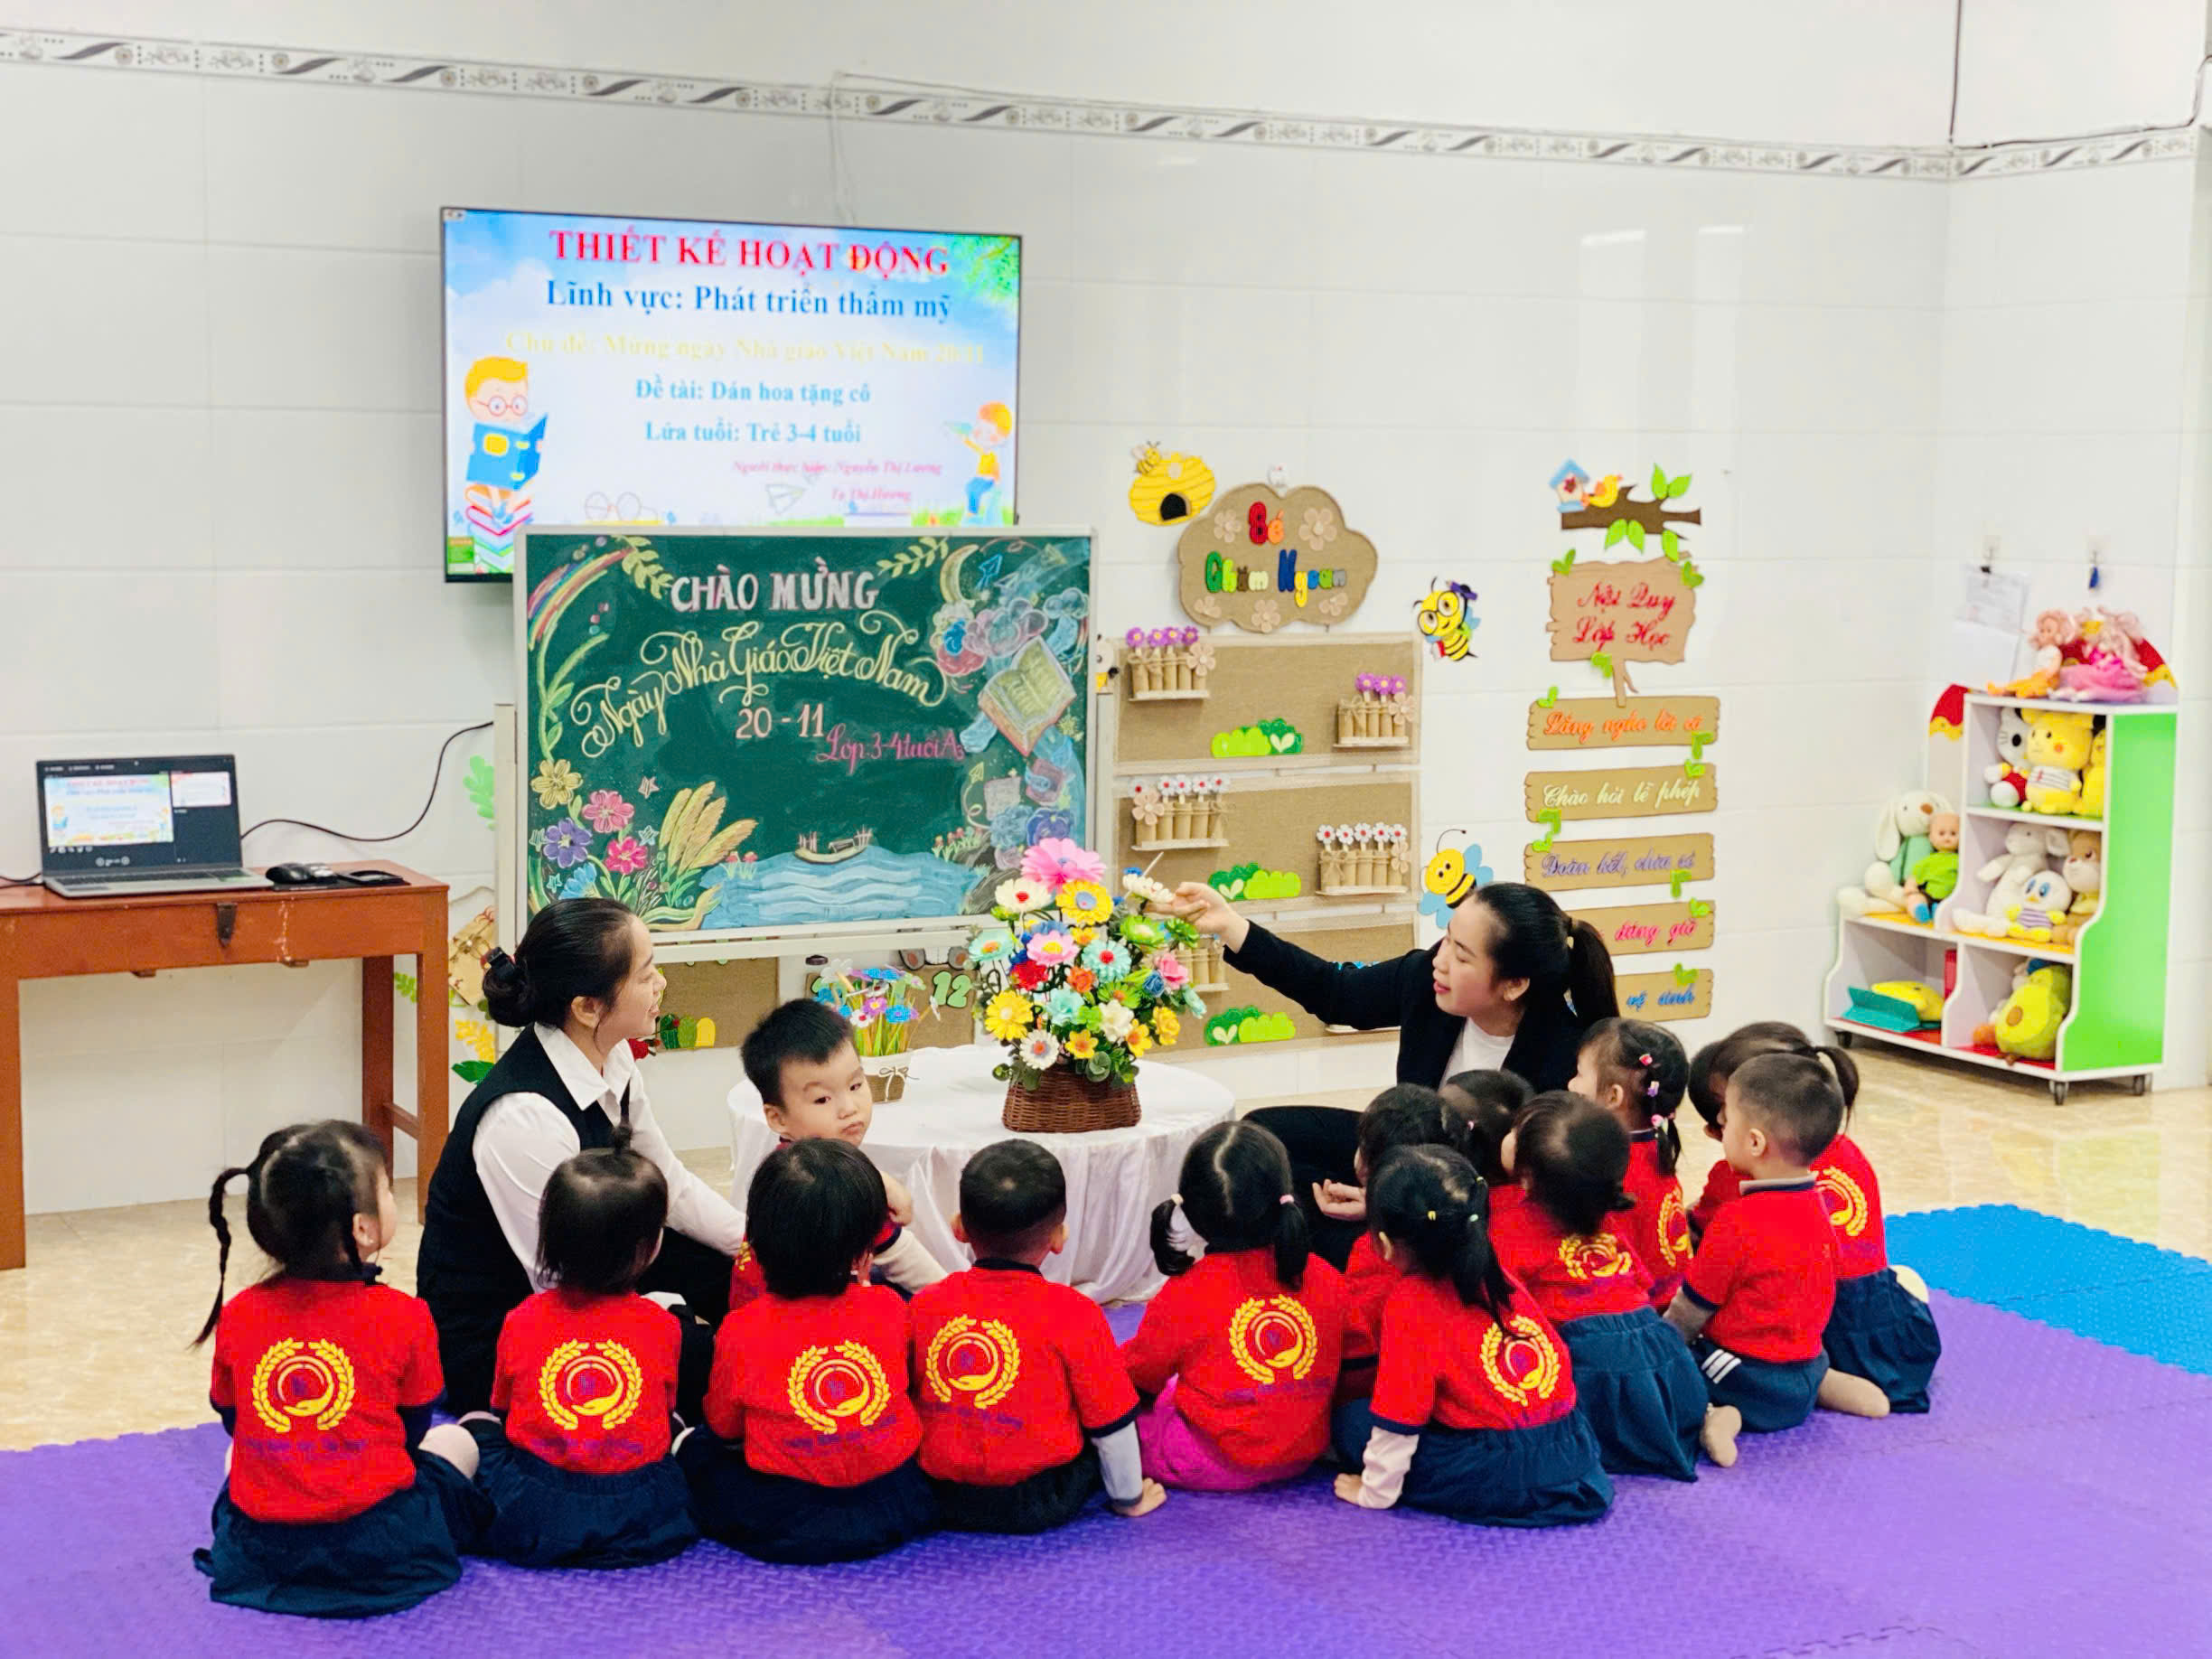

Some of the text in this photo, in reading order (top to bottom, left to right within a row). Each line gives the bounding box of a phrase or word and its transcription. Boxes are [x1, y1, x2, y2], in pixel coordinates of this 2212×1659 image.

[549, 225, 949, 281] THIẾT KẾ HOẠT ĐỘNG
[547, 280, 951, 323] Lĩnh vực: Phát triển thẩm mỹ
[635, 375, 872, 407] Đề tài: Dán hoa tặng cô
[645, 421, 687, 441] Lứa
[693, 417, 741, 442] tuổi:
[787, 423, 817, 443] 3-4
[823, 419, 862, 443] tuổi
[1249, 501, 1285, 546] Bé
[670, 556, 880, 613] CHÀO MỪNG
[1626, 621, 1670, 651] Học
[570, 610, 948, 758] Ngày Nhà Giáo Việt Nam
[736, 708, 772, 739] 20
[797, 703, 825, 738] 11
[1543, 784, 1589, 808] Chào
[1597, 782, 1625, 804] hỏi
[1654, 778, 1701, 810] phép
